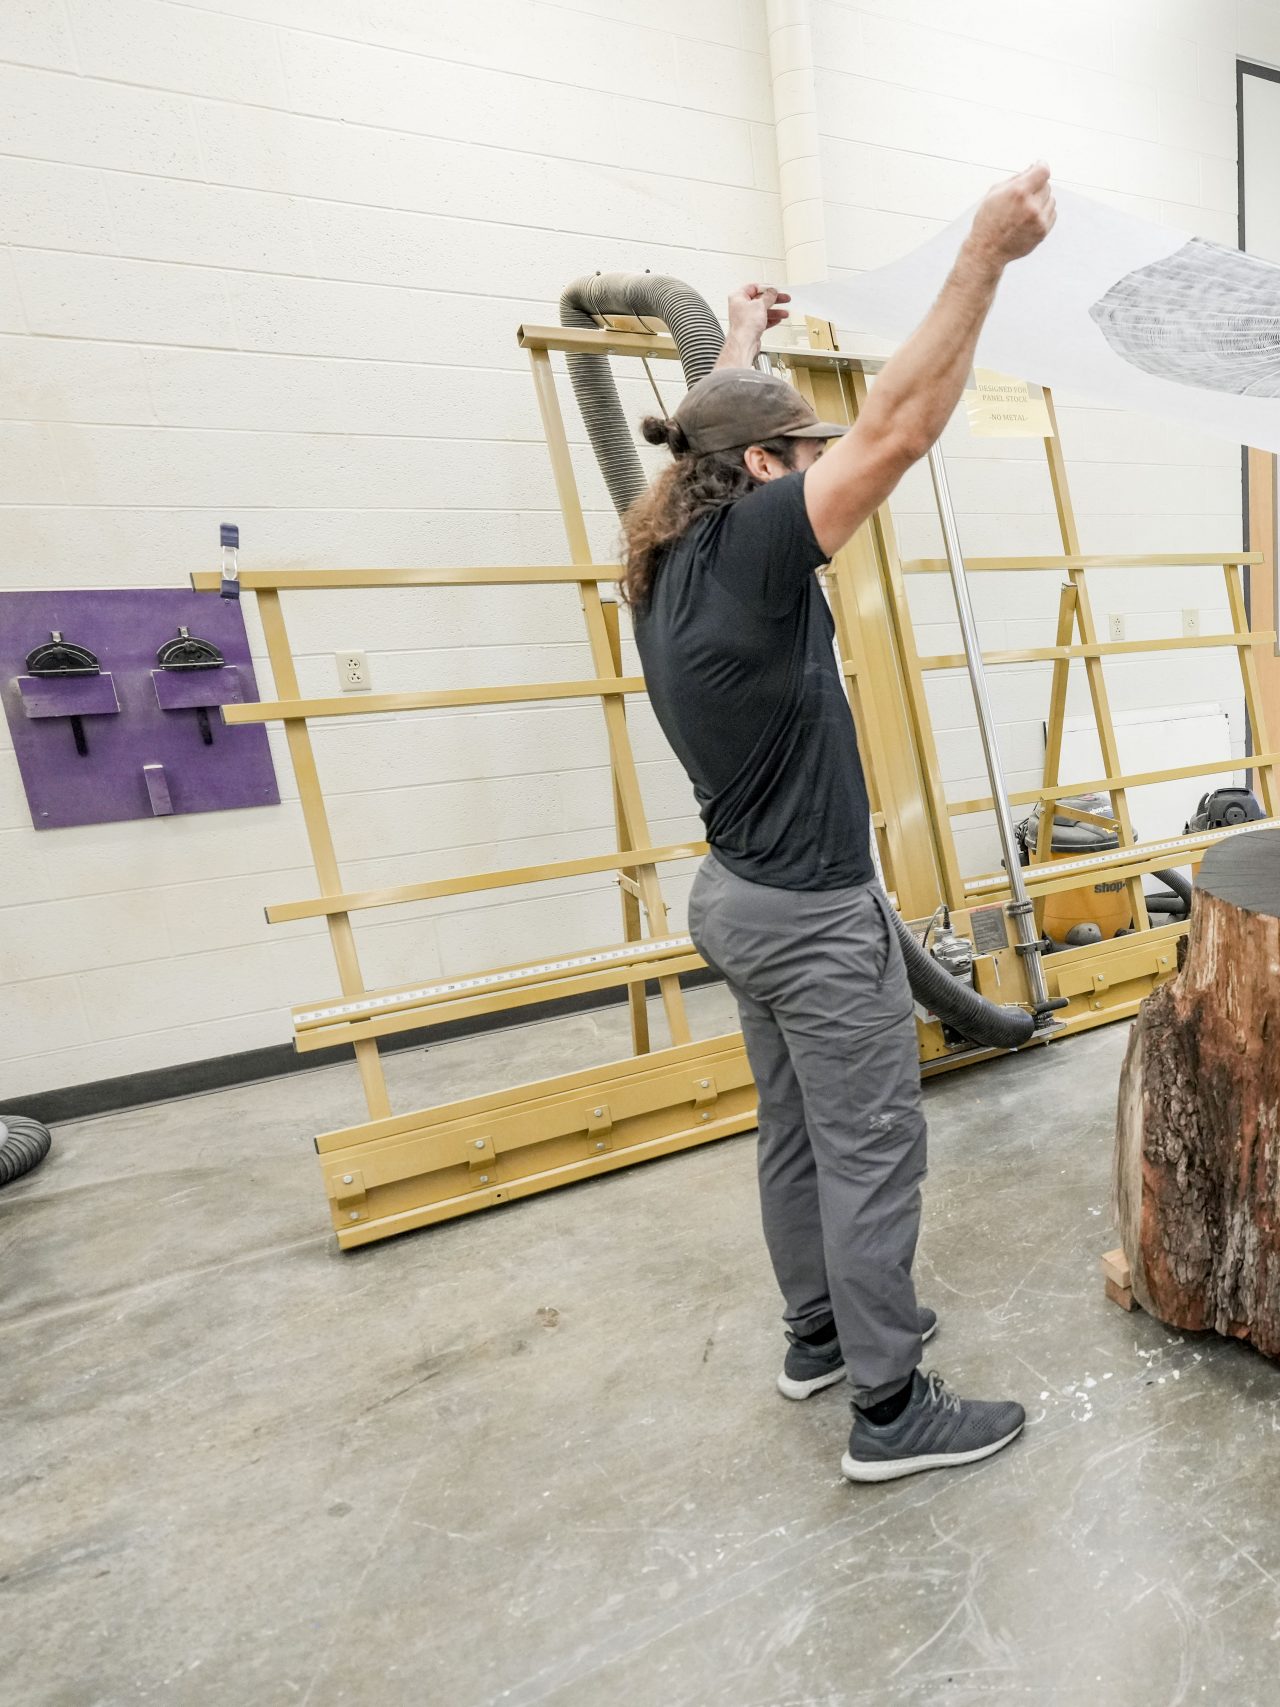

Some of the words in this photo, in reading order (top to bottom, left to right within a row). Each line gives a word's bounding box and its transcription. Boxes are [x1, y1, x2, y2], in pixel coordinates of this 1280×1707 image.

[978, 385, 1013, 393] DESIGNED
[1013, 386, 1028, 394] FOR
[982, 394, 1004, 402] PANEL
[1005, 395, 1028, 403] STOCK
